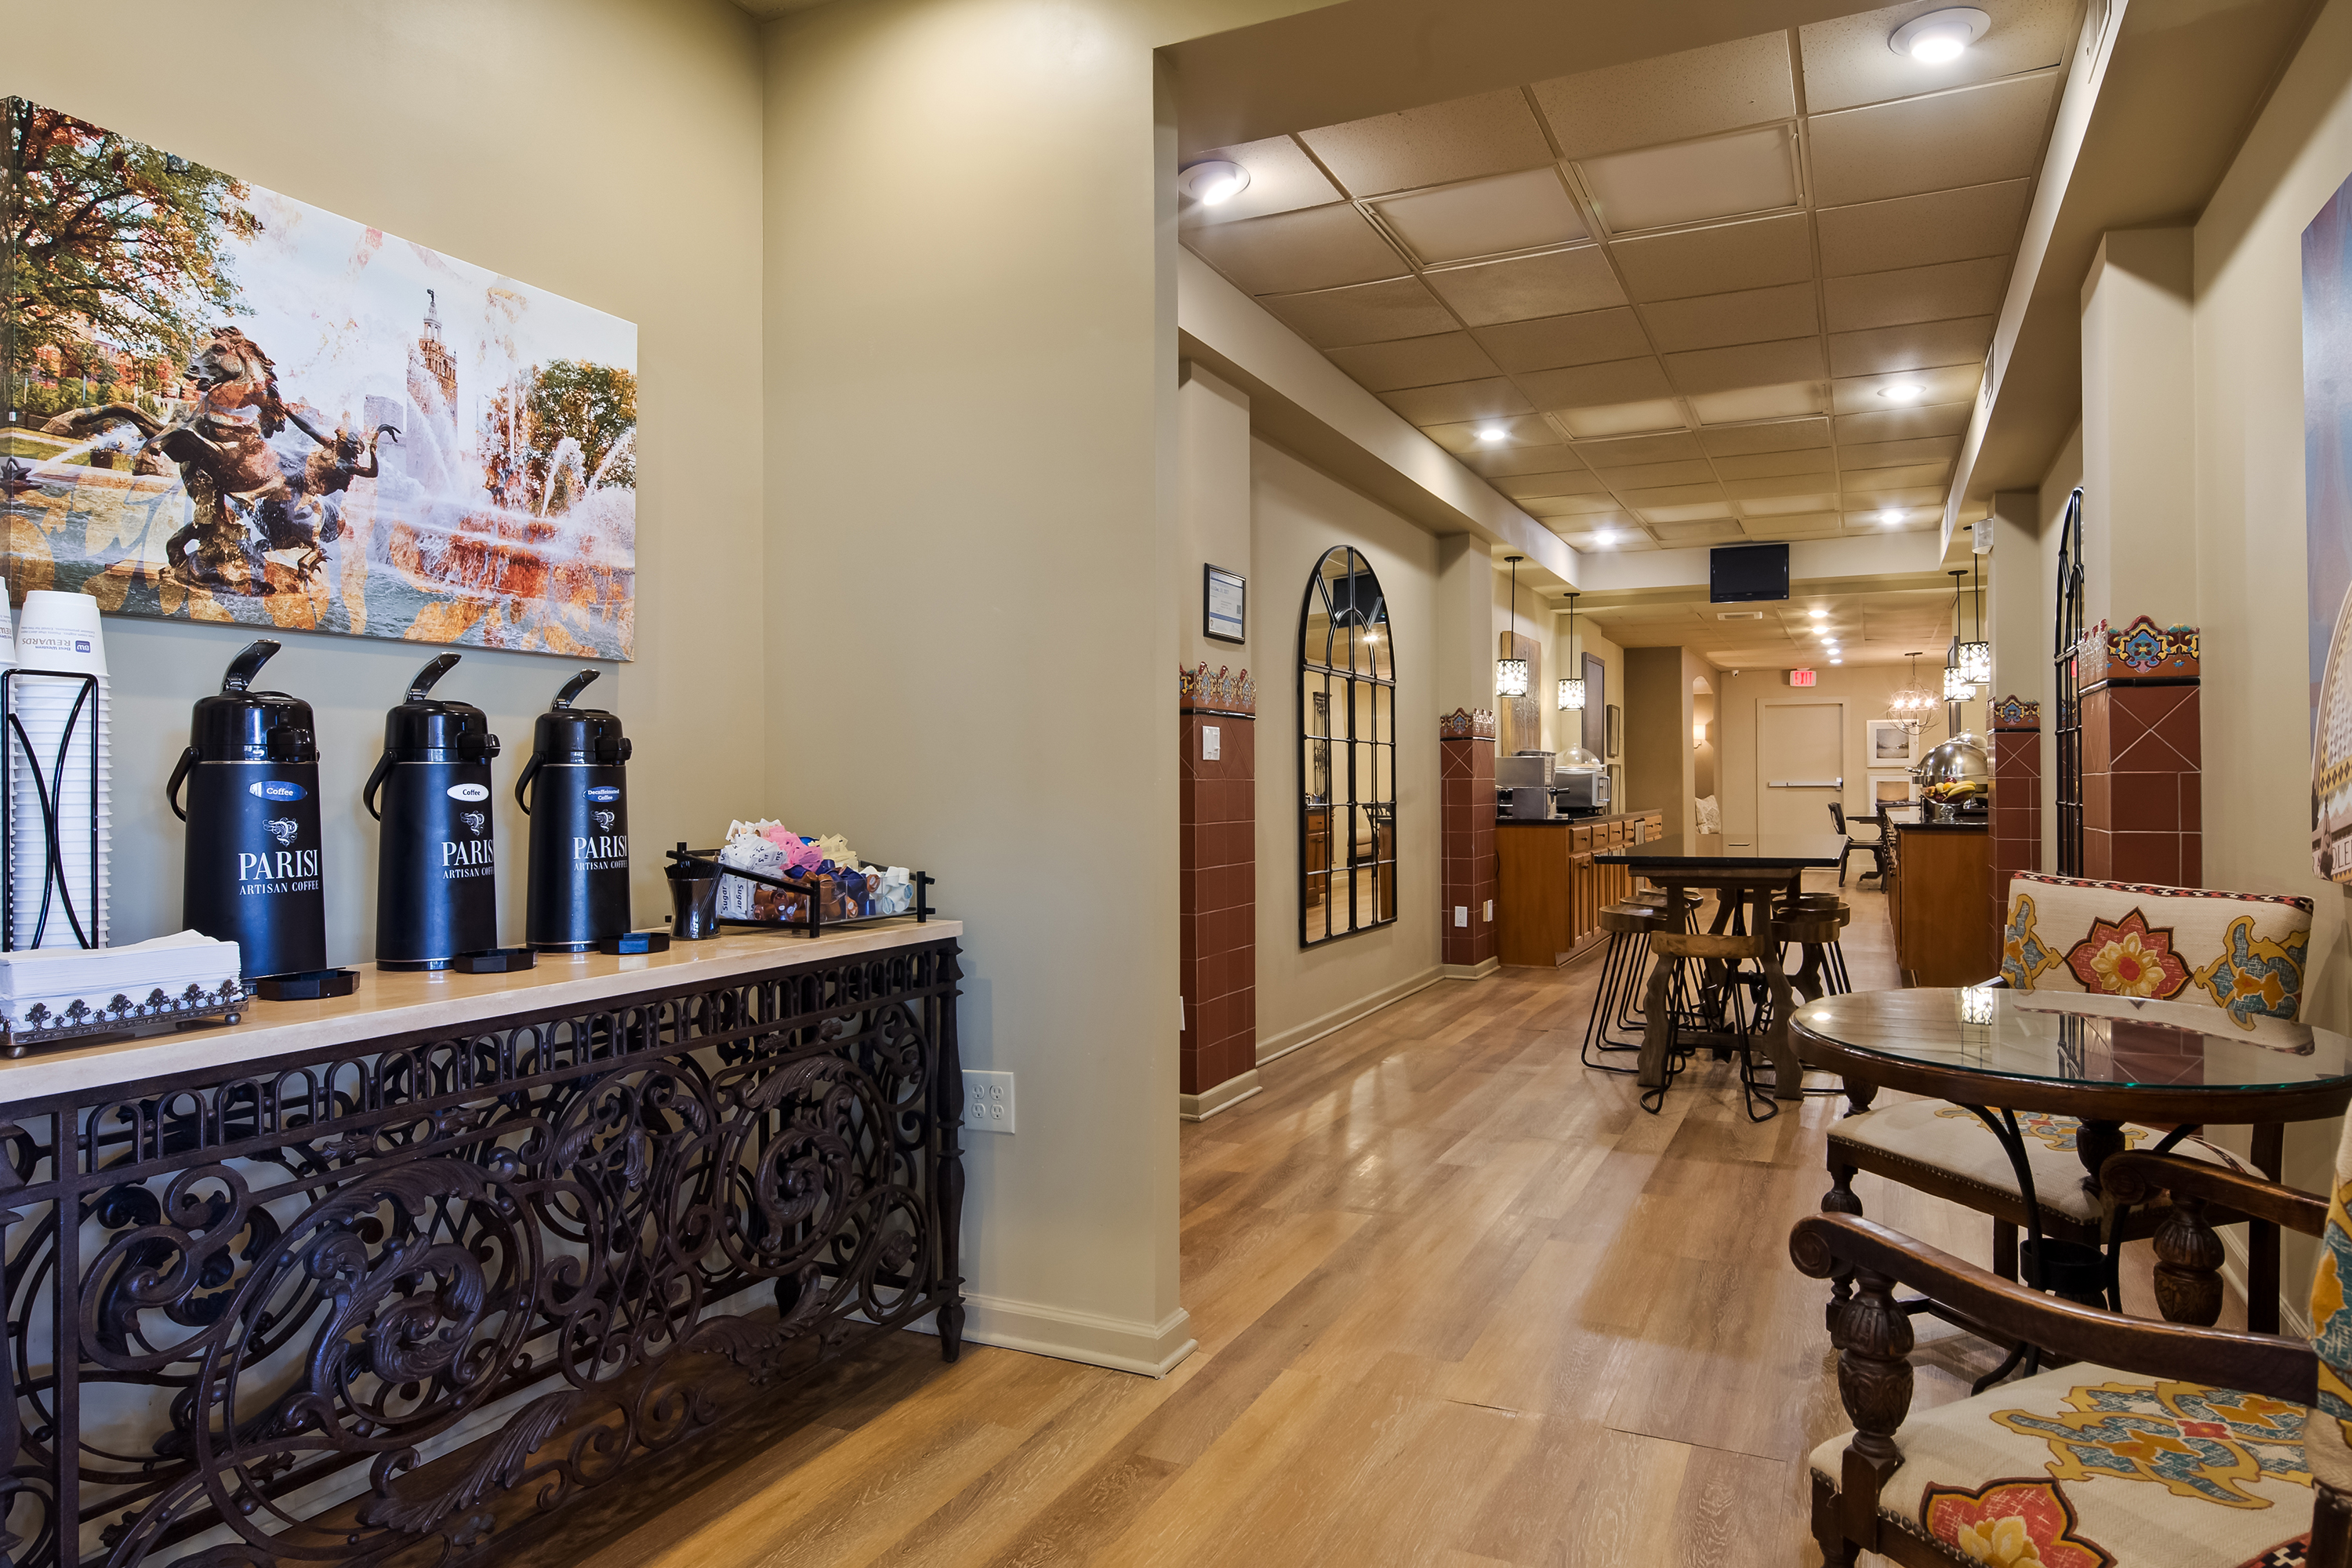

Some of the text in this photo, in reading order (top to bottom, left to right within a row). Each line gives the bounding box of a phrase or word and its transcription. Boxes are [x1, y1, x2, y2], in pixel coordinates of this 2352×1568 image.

[22, 637, 71, 647] REWARDS
[1795, 671, 1813, 685] EXIT
[266, 787, 294, 797] Coffee
[441, 839, 494, 867] PARIS
[573, 835, 627, 860] PARISI
[238, 849, 318, 881] PARISI
[574, 860, 608, 871] ARTISAN
[442, 867, 480, 880] ARTISAN
[239, 880, 320, 895] ARTISAN COFFEE
